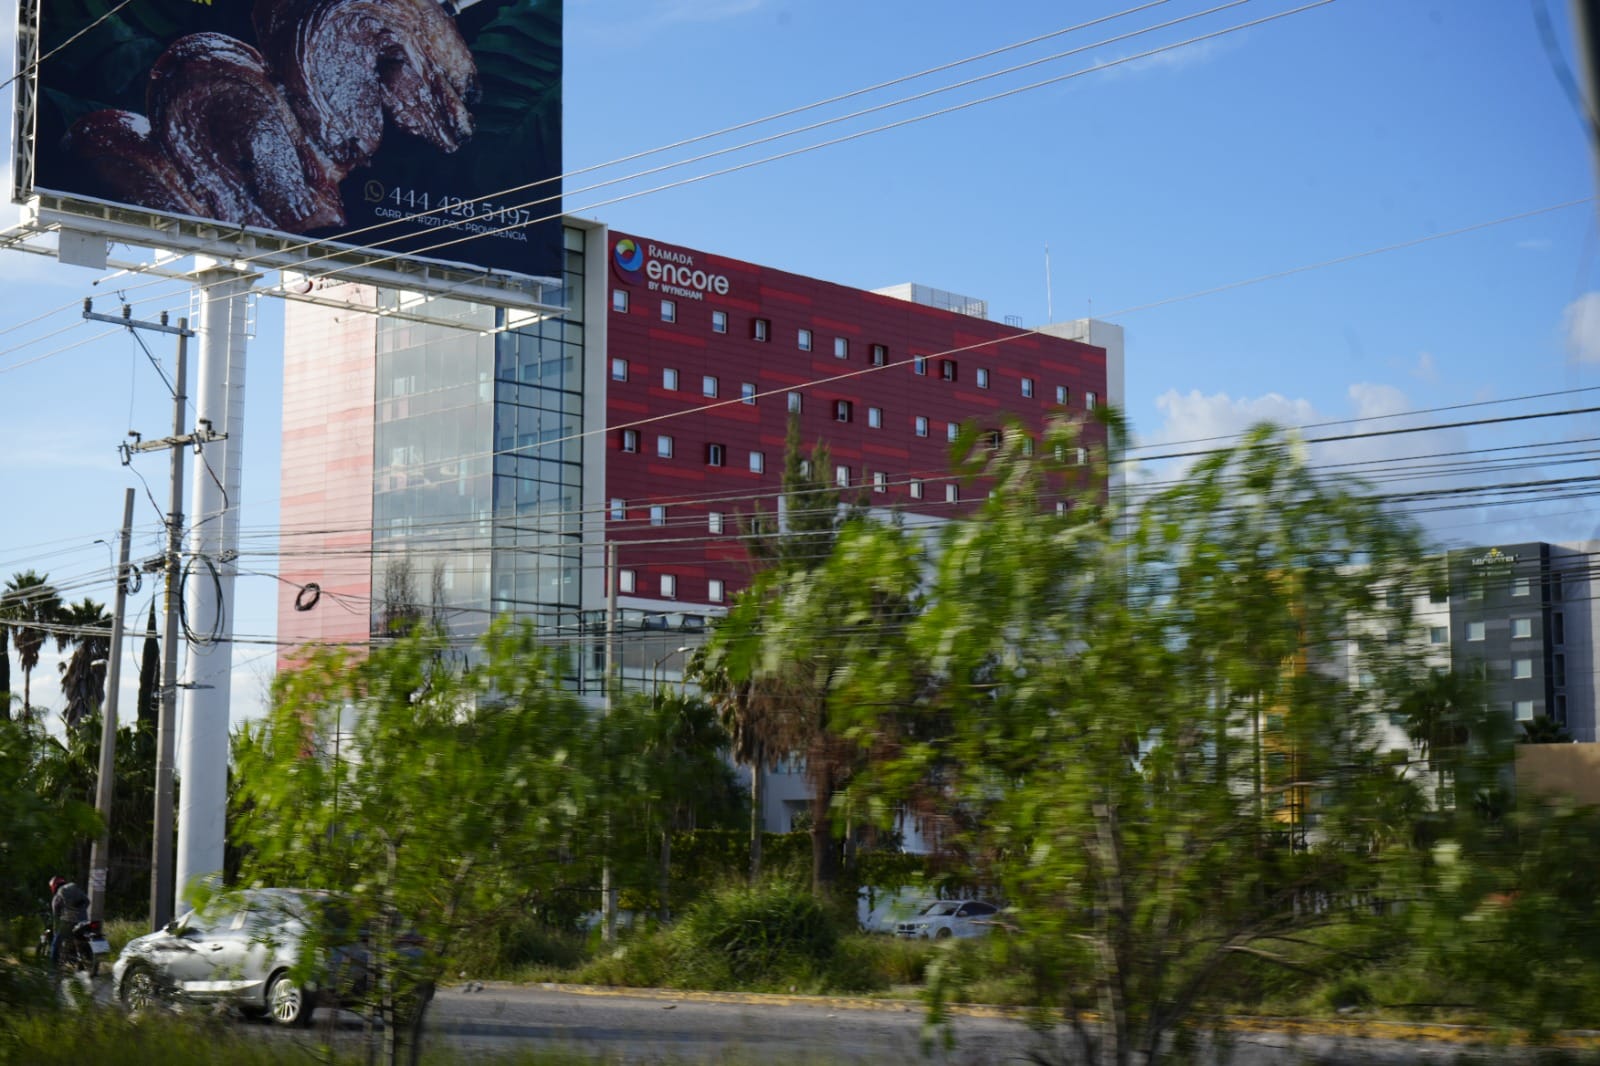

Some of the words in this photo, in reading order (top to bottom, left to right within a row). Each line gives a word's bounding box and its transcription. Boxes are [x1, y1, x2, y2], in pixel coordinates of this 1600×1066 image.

[388, 187, 429, 210] 444
[437, 196, 475, 218] 428
[481, 203, 530, 228] 5497
[465, 223, 528, 242] PROVIDENCIA
[648, 245, 693, 266] RAMADA
[646, 260, 729, 295] encore
[648, 281, 659, 291] BY
[662, 284, 703, 301] WYNDHAM
